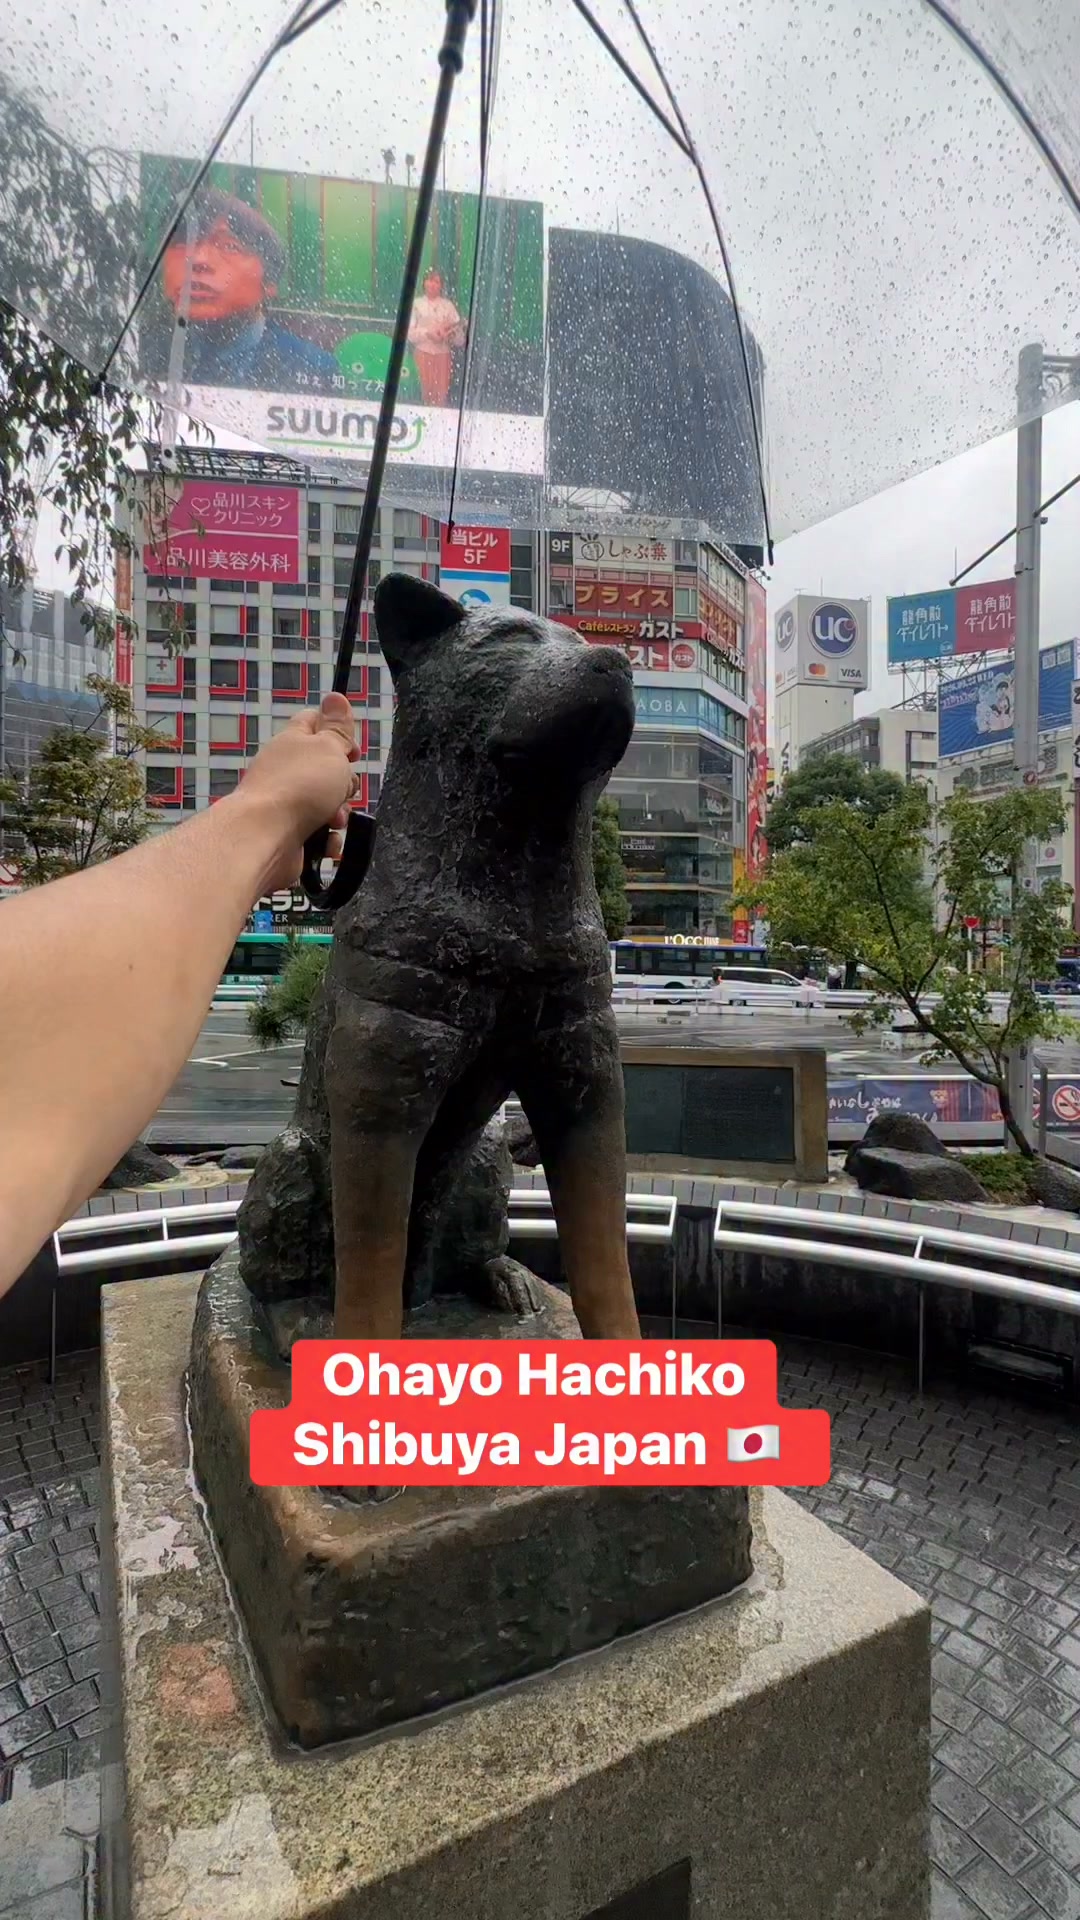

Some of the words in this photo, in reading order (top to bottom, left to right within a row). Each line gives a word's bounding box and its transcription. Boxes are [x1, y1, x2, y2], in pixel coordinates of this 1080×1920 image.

[213, 492, 290, 510] 品川スキン
[213, 511, 282, 527] クリニック
[452, 529, 498, 547] 当ビル
[552, 538, 570, 552] 9F
[463, 548, 488, 565] 5F
[609, 539, 667, 561] しゃぶ葉
[167, 547, 291, 573] 品川美容外科
[970, 593, 1012, 616] 龍角散
[902, 605, 941, 626] 龍角散
[640, 620, 684, 639] ガスト
[619, 643, 664, 668] スト
[840, 668, 862, 678] VISA
